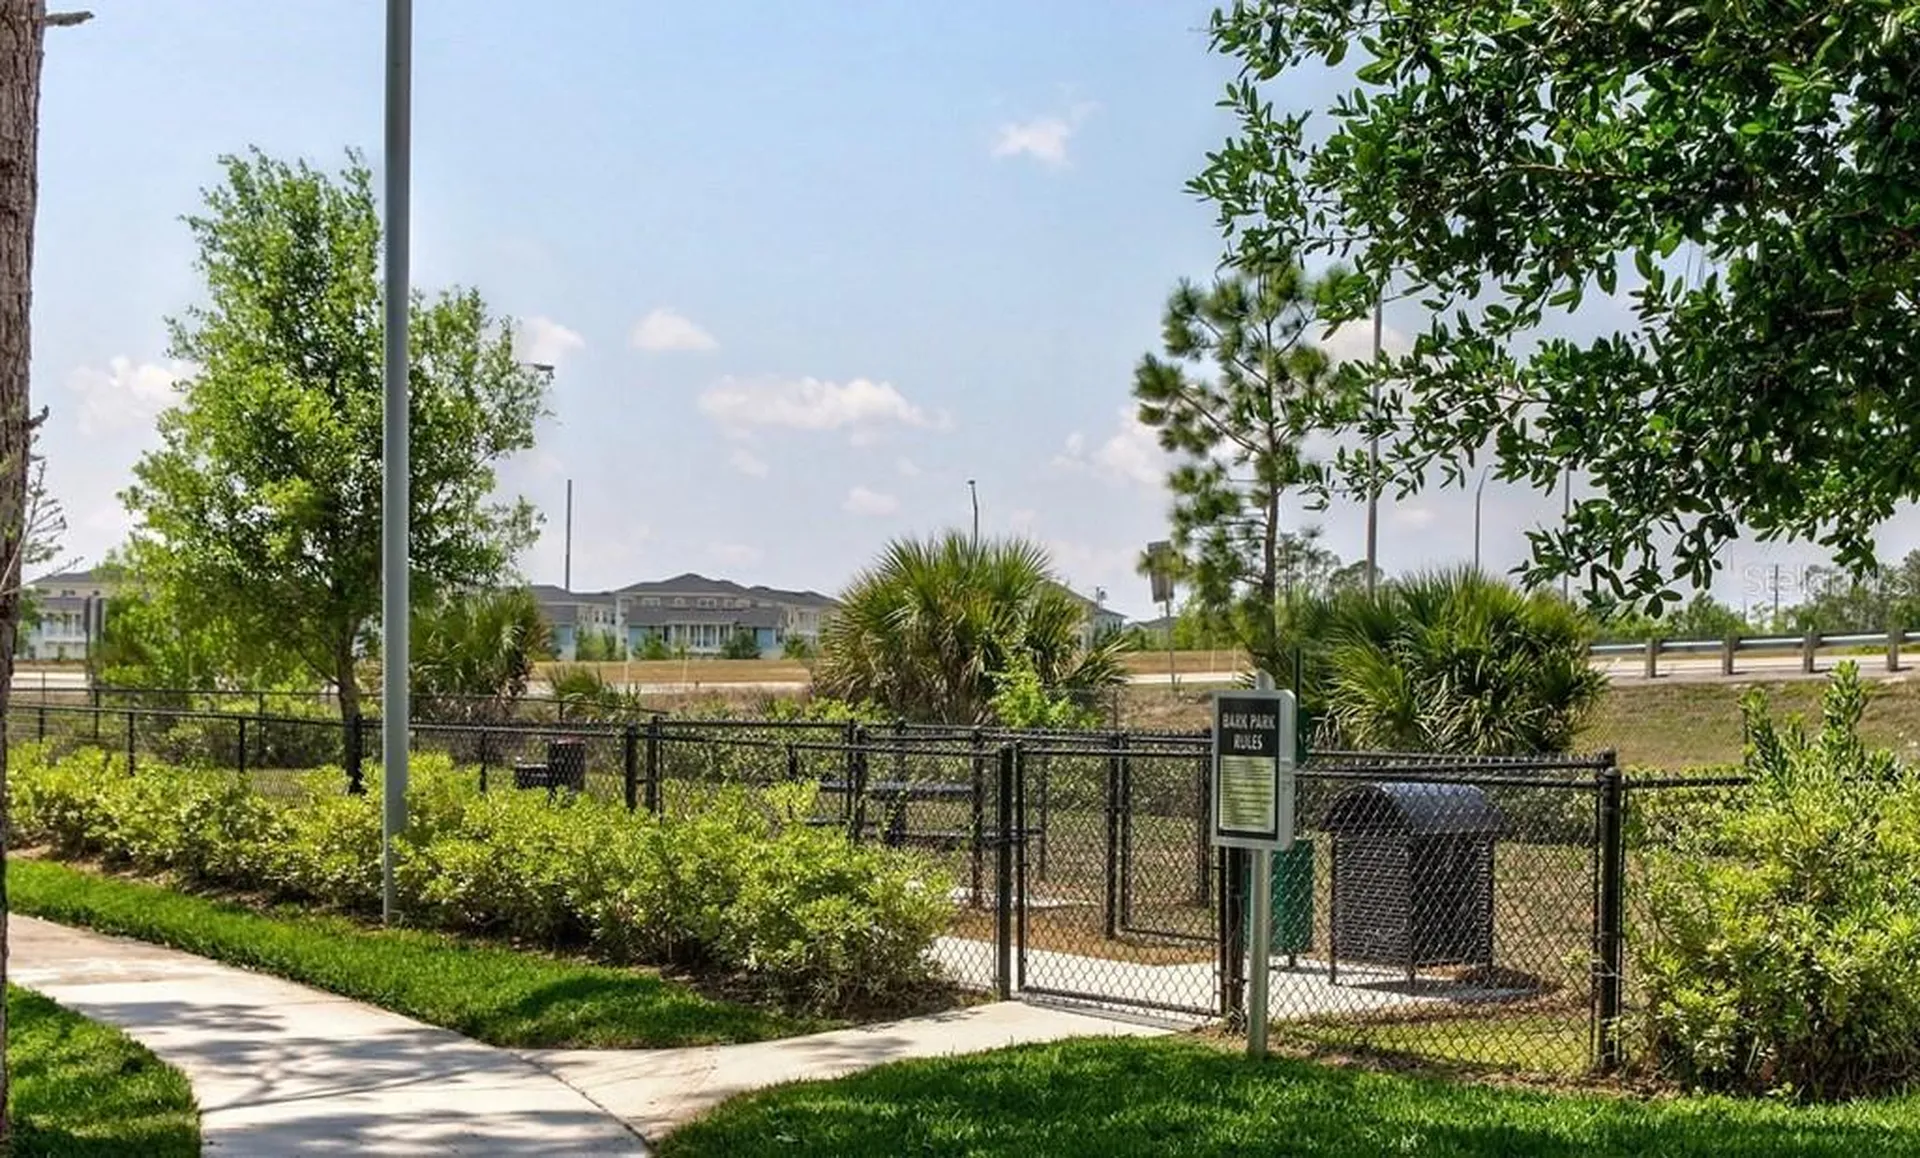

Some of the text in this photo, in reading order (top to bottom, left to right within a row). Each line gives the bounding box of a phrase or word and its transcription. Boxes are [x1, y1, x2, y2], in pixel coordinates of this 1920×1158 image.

[1222, 712, 1276, 730] BARK PARK
[1233, 734, 1263, 750] RULES
